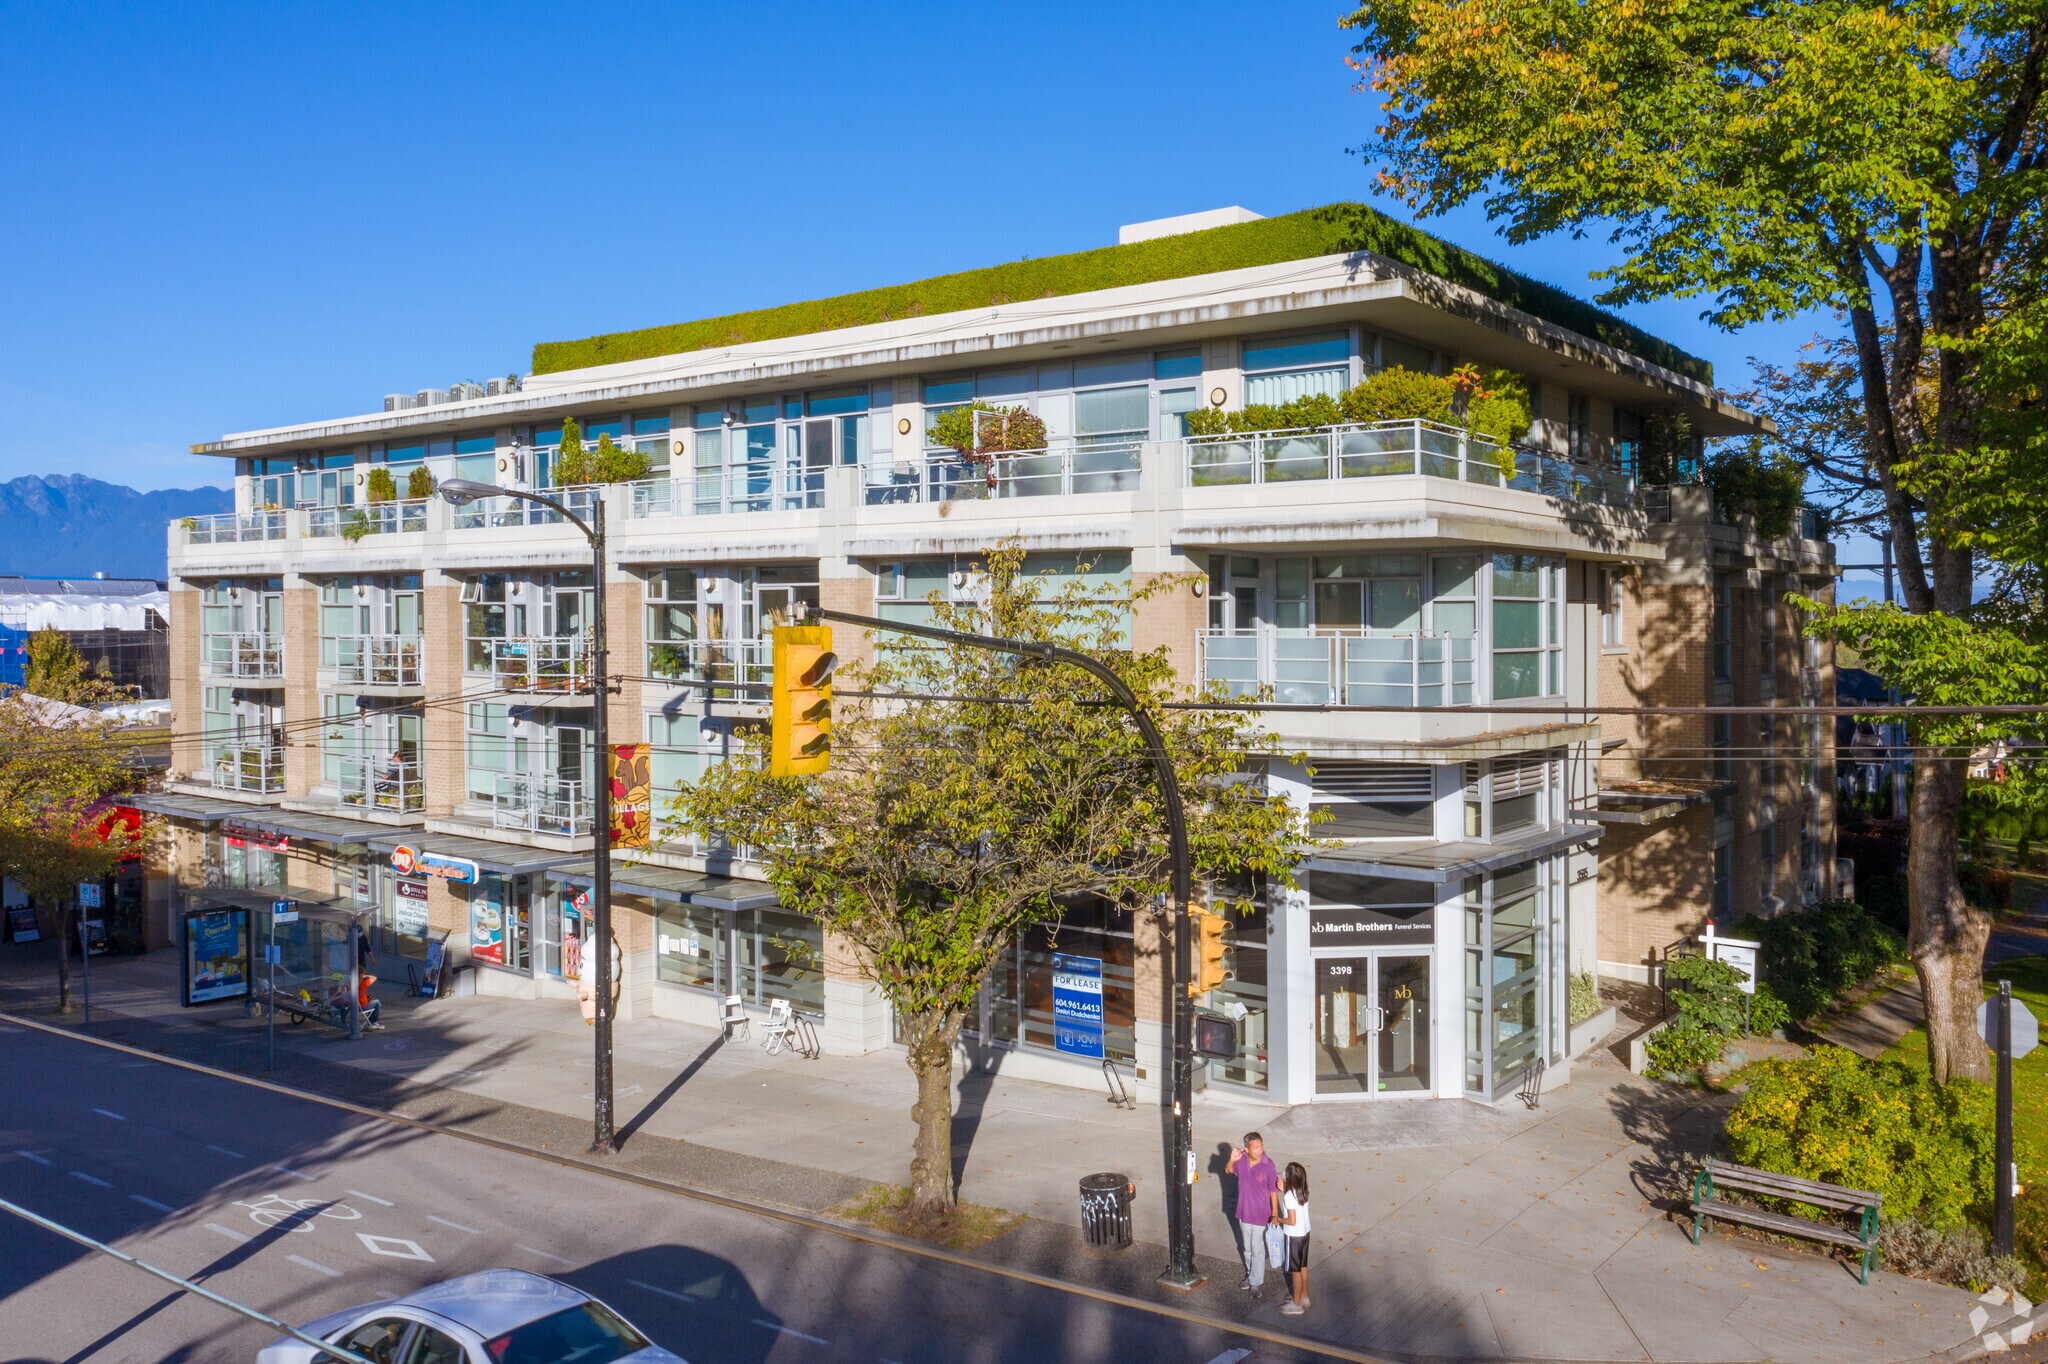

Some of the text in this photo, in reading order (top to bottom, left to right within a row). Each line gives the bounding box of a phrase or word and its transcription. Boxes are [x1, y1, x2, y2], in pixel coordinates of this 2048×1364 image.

[609, 803, 650, 814] VILLAGE
[394, 852, 411, 869] DQ
[277, 902, 285, 912] T
[407, 899, 416, 907] FOR
[1325, 923, 1354, 932] Martin
[1356, 922, 1393, 931] Brothers
[1330, 966, 1352, 975] 3398
[1055, 976, 1099, 989] FOR LEASE
[1055, 998, 1100, 1013] 604.961.6413
[1055, 1007, 1070, 1016] Dmitri
[1071, 1010, 1100, 1020] Dudchenko
[1077, 1034, 1097, 1045] JOVI
